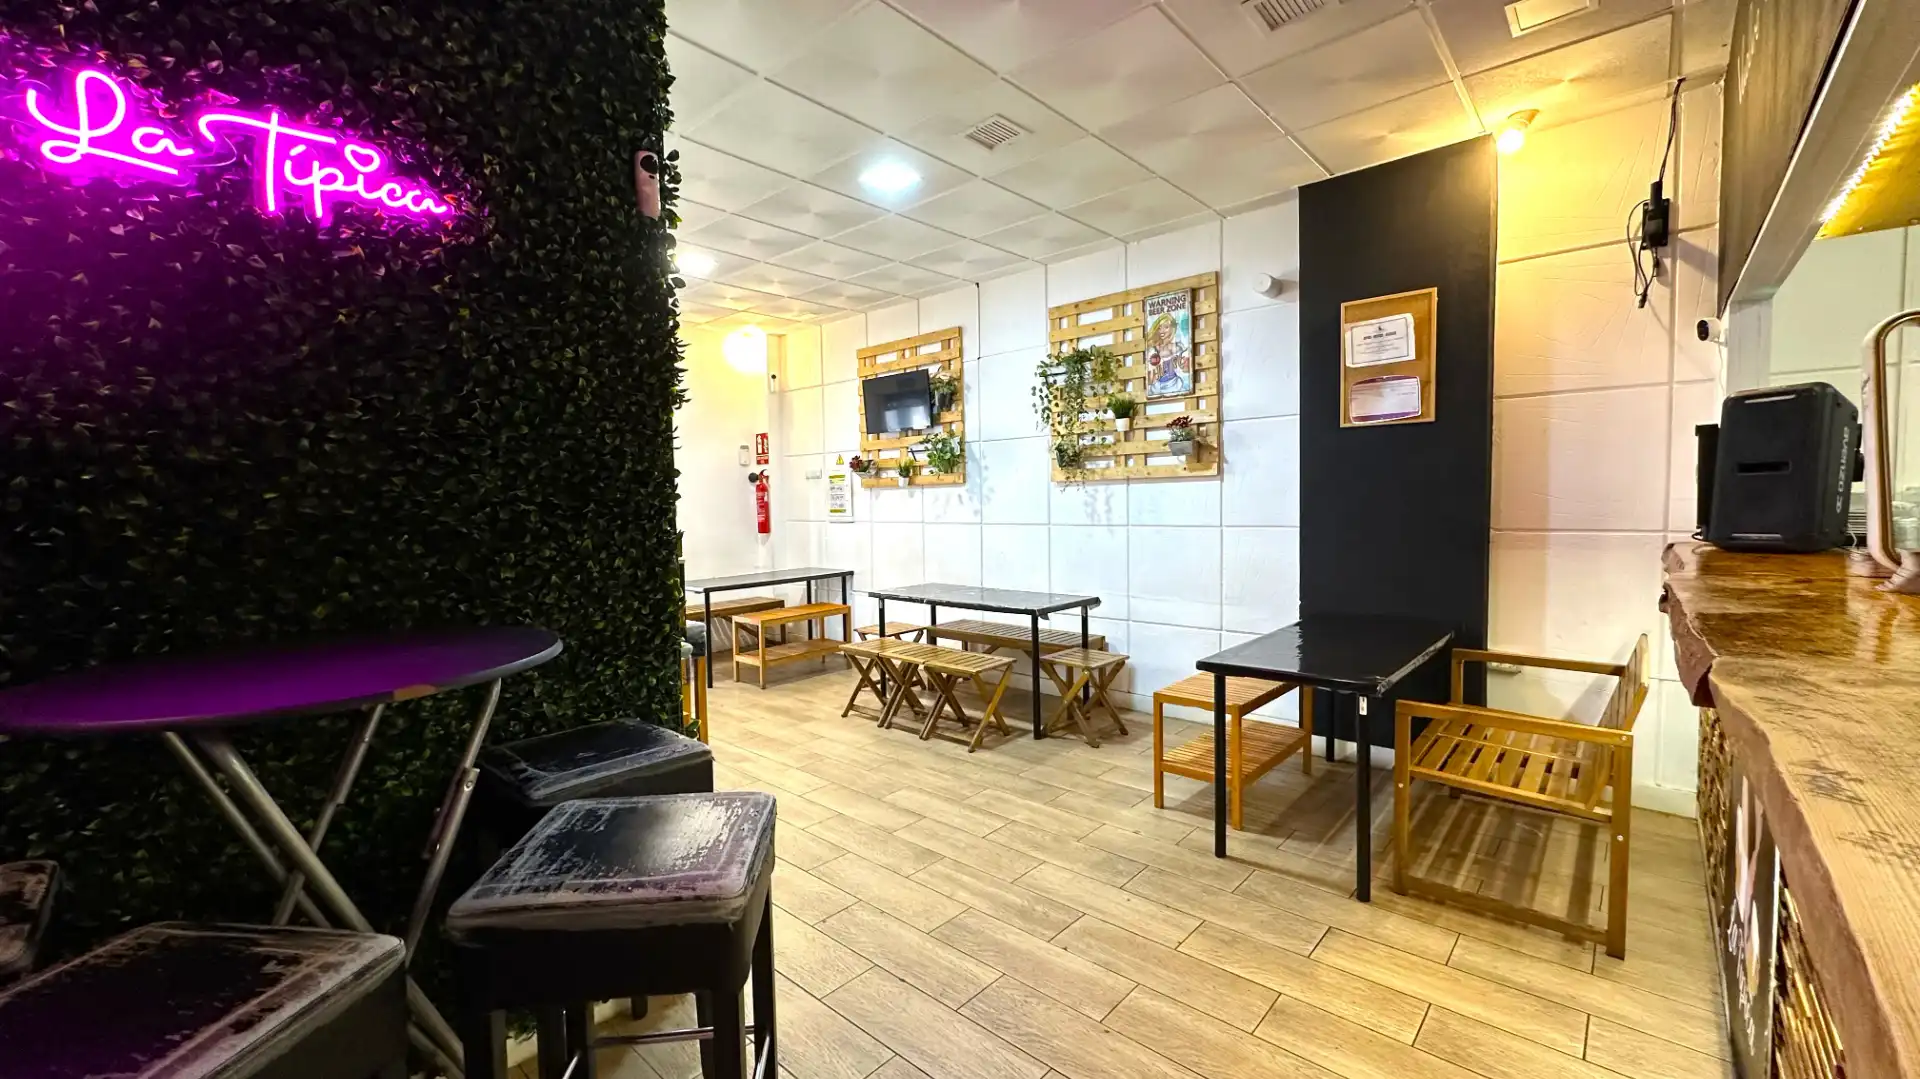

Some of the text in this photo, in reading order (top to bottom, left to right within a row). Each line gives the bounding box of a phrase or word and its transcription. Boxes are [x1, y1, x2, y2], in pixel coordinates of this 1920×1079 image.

[25, 69, 194, 176] La
[1148, 294, 1186, 308] WARNING
[1148, 302, 1186, 316] BEER ZONE
